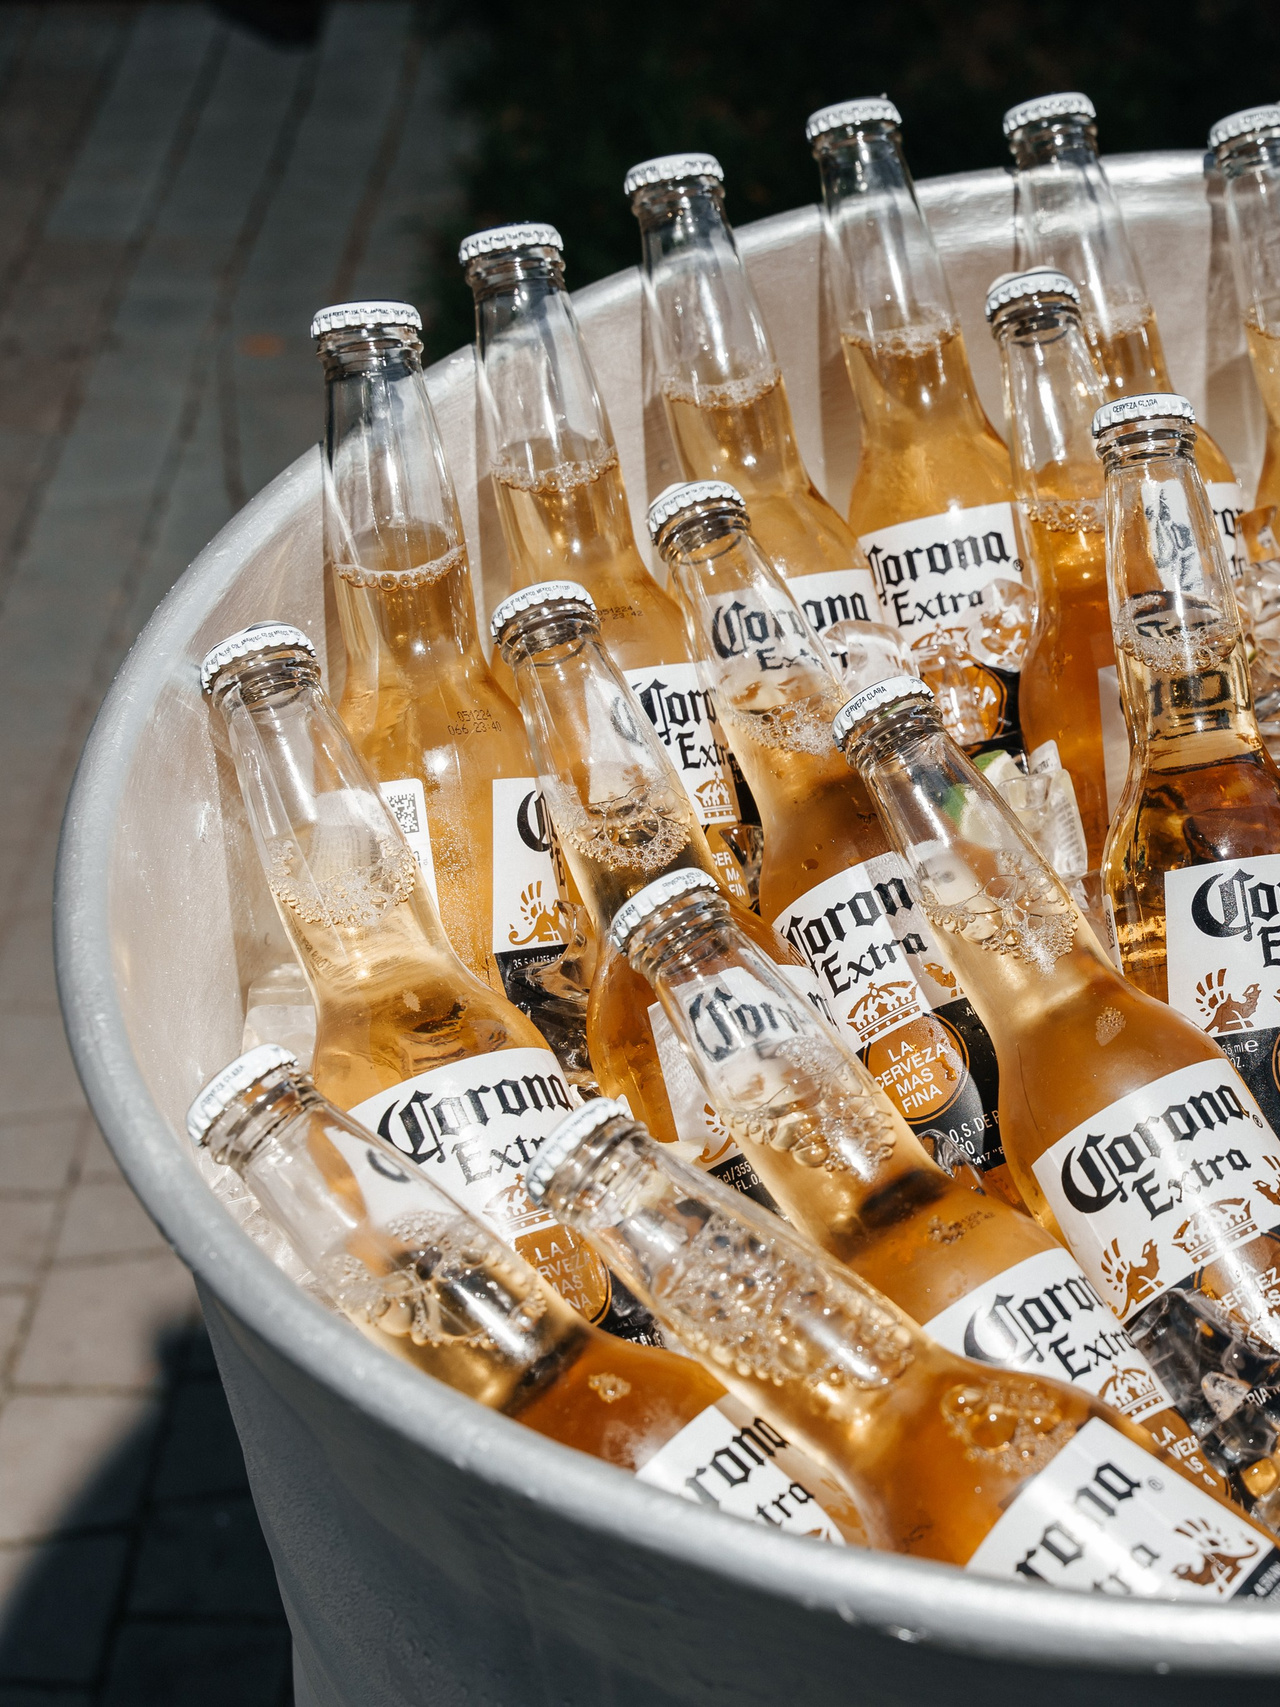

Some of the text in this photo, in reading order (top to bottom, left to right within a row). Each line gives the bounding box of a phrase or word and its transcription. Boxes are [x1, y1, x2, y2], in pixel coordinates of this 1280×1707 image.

[889, 589, 983, 627] Extra
[844, 685, 887, 718] CERVEZA CLARA
[820, 932, 929, 998] Extra
[874, 1043, 950, 1091] CERVEZA
[887, 1040, 913, 1063] LA
[896, 1067, 934, 1098] MAS
[901, 1083, 943, 1114] FINA
[377, 1073, 576, 1165] Corona
[973, 1113, 993, 1132] DE
[1061, 1084, 1249, 1214] Corona
[1131, 1148, 1252, 1221] Extra
[535, 1241, 565, 1262] LA
[1151, 1426, 1177, 1447] LA
